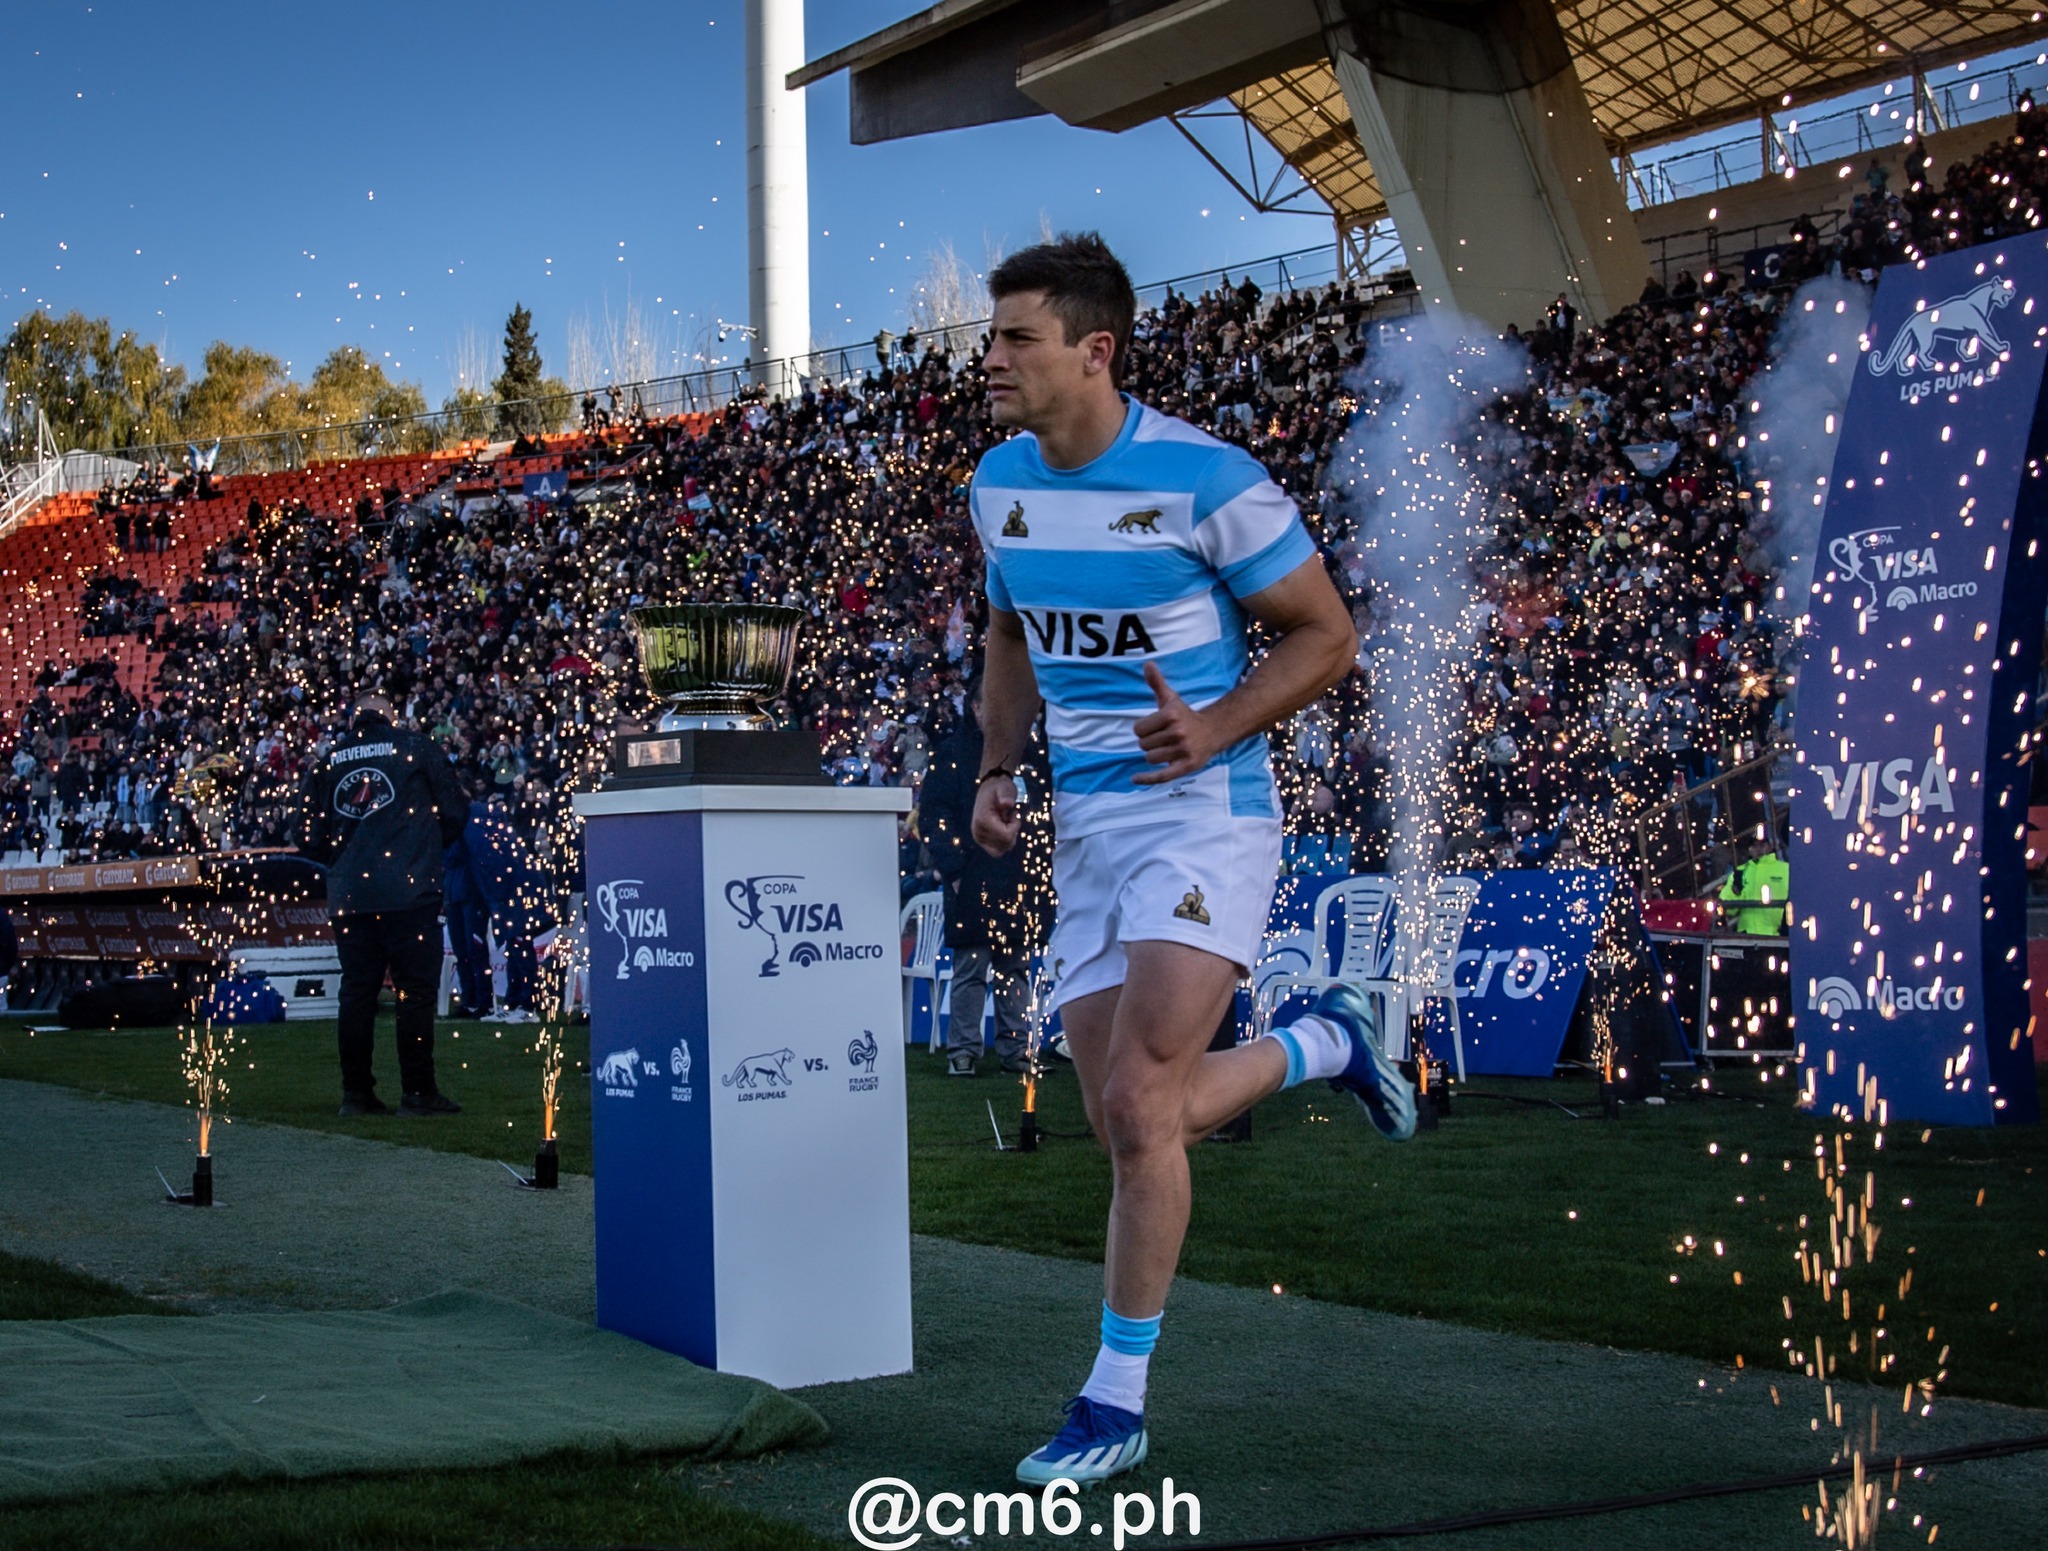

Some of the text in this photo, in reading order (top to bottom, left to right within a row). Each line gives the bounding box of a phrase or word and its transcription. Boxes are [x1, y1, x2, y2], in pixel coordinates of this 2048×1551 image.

[1764, 253, 1779, 278] C
[1901, 381, 1931, 400] LOS
[540, 476, 552, 499] A
[1869, 547, 1939, 581] VISA
[1920, 582, 1978, 602] Macro
[1018, 610, 1158, 658] VISA
[330, 742, 394, 767] PREVENCION
[341, 771, 382, 791] ROAD
[1808, 756, 1956, 820] VISA
[618, 887, 640, 900] COPA
[763, 883, 797, 895] COPA
[622, 908, 668, 938] VISA
[770, 903, 844, 933] VISA
[656, 948, 694, 967] Macro
[826, 942, 883, 961] Macro
[1867, 979, 1965, 1012] Macro
[849, 1076, 879, 1085] FRANCE
[849, 1084, 879, 1093] RUGBY
[738, 1091, 787, 1102] LOS PUMAS
